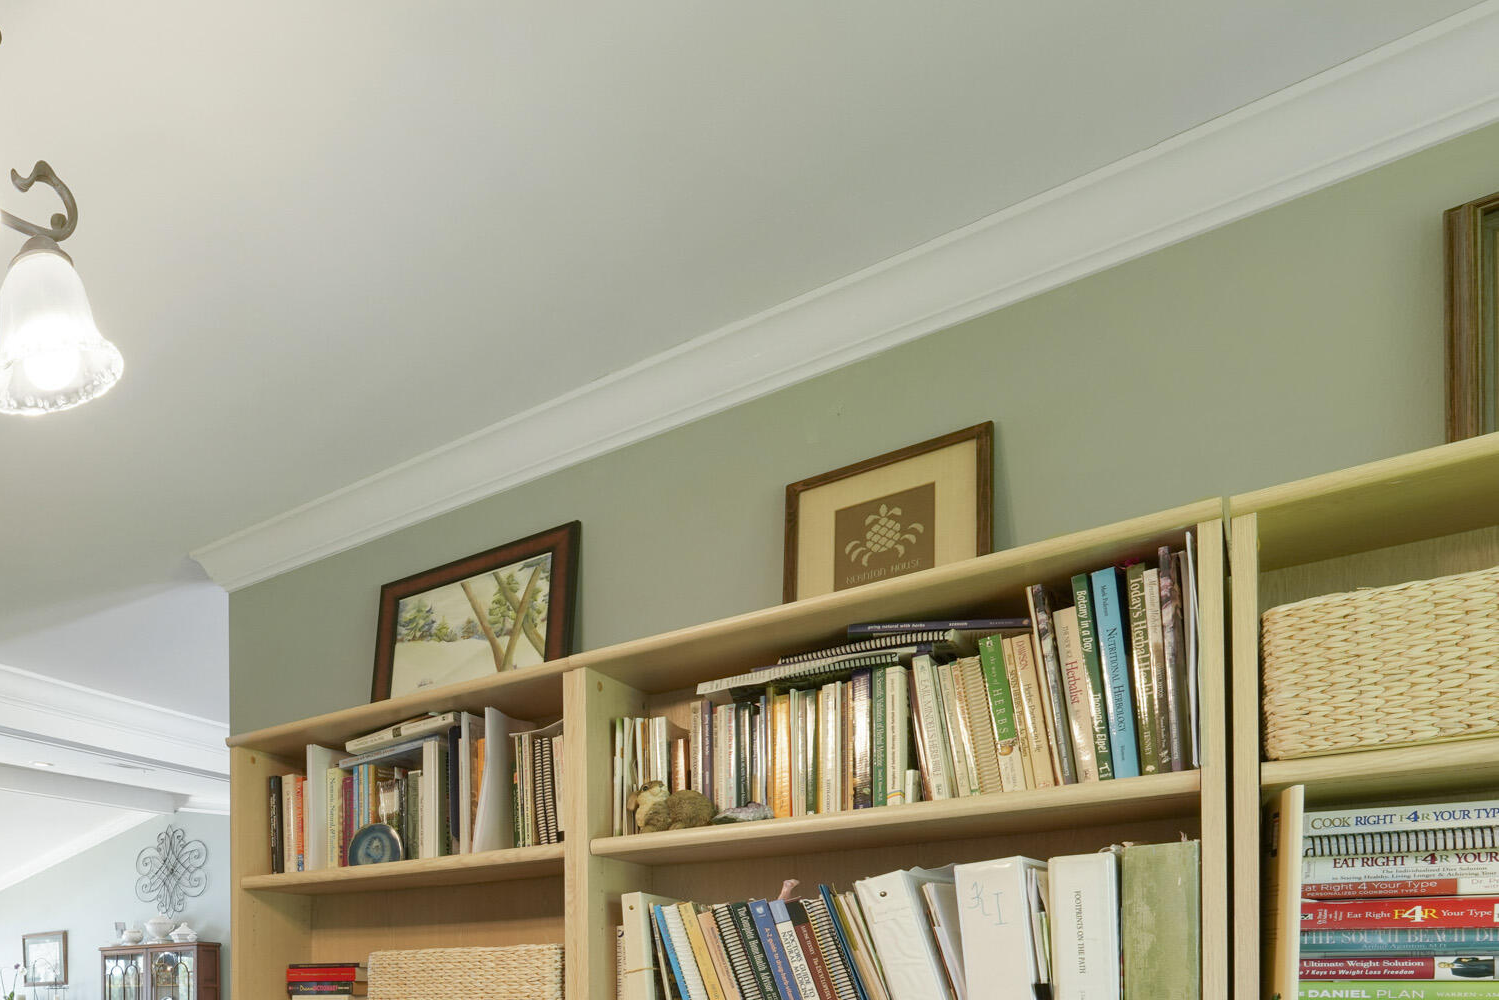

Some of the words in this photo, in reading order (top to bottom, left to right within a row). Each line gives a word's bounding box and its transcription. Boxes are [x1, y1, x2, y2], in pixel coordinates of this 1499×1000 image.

[1076, 590, 1088, 619] Botany
[1129, 574, 1147, 618] Today's
[1080, 620, 1090, 629] in
[1081, 637, 1093, 653] Day
[1132, 620, 1150, 660] Herbal
[1106, 627, 1120, 682] NUTRITIONAL
[1064, 660, 1082, 705] Herbalist
[992, 689, 1008, 734] HERBS
[1112, 685, 1126, 733] HERBOLOGY
[1095, 733, 1108, 753] Elpel
[1311, 817, 1351, 830] COOK
[1355, 813, 1396, 826] RIGHT
[1433, 809, 1471, 821] YOUR
[1333, 857, 1359, 869] EAT
[1361, 855, 1409, 867] RIGHT
[1455, 852, 1499, 864] YOUR
[1320, 884, 1354, 892] Right
[1358, 882, 1368, 890] 4
[1407, 881, 1437, 889] Type
[1073, 890, 1084, 930] FOOTPRINTS
[1365, 911, 1390, 919] Right
[1469, 909, 1492, 917] Type
[764, 927, 772, 938] A-Z
[1076, 931, 1084, 940] ON
[1341, 930, 1399, 944] SOUTH
[1408, 929, 1465, 943] BEACH
[739, 917, 755, 939] Complete
[760, 972, 775, 993] Advisor
[1077, 943, 1085, 956] THE
[780, 931, 793, 961] NATURAL
[792, 963, 809, 1000] MEDICINE
[1078, 957, 1086, 974] PATH
[1347, 960, 1379, 968] Weight
[799, 964, 810, 986] GUIDE
[808, 988, 815, 998] TO
[813, 966, 831, 999] ENCYCLOPEDIA
[1308, 990, 1371, 998] DANIEL
[1377, 990, 1425, 998] PLAN
